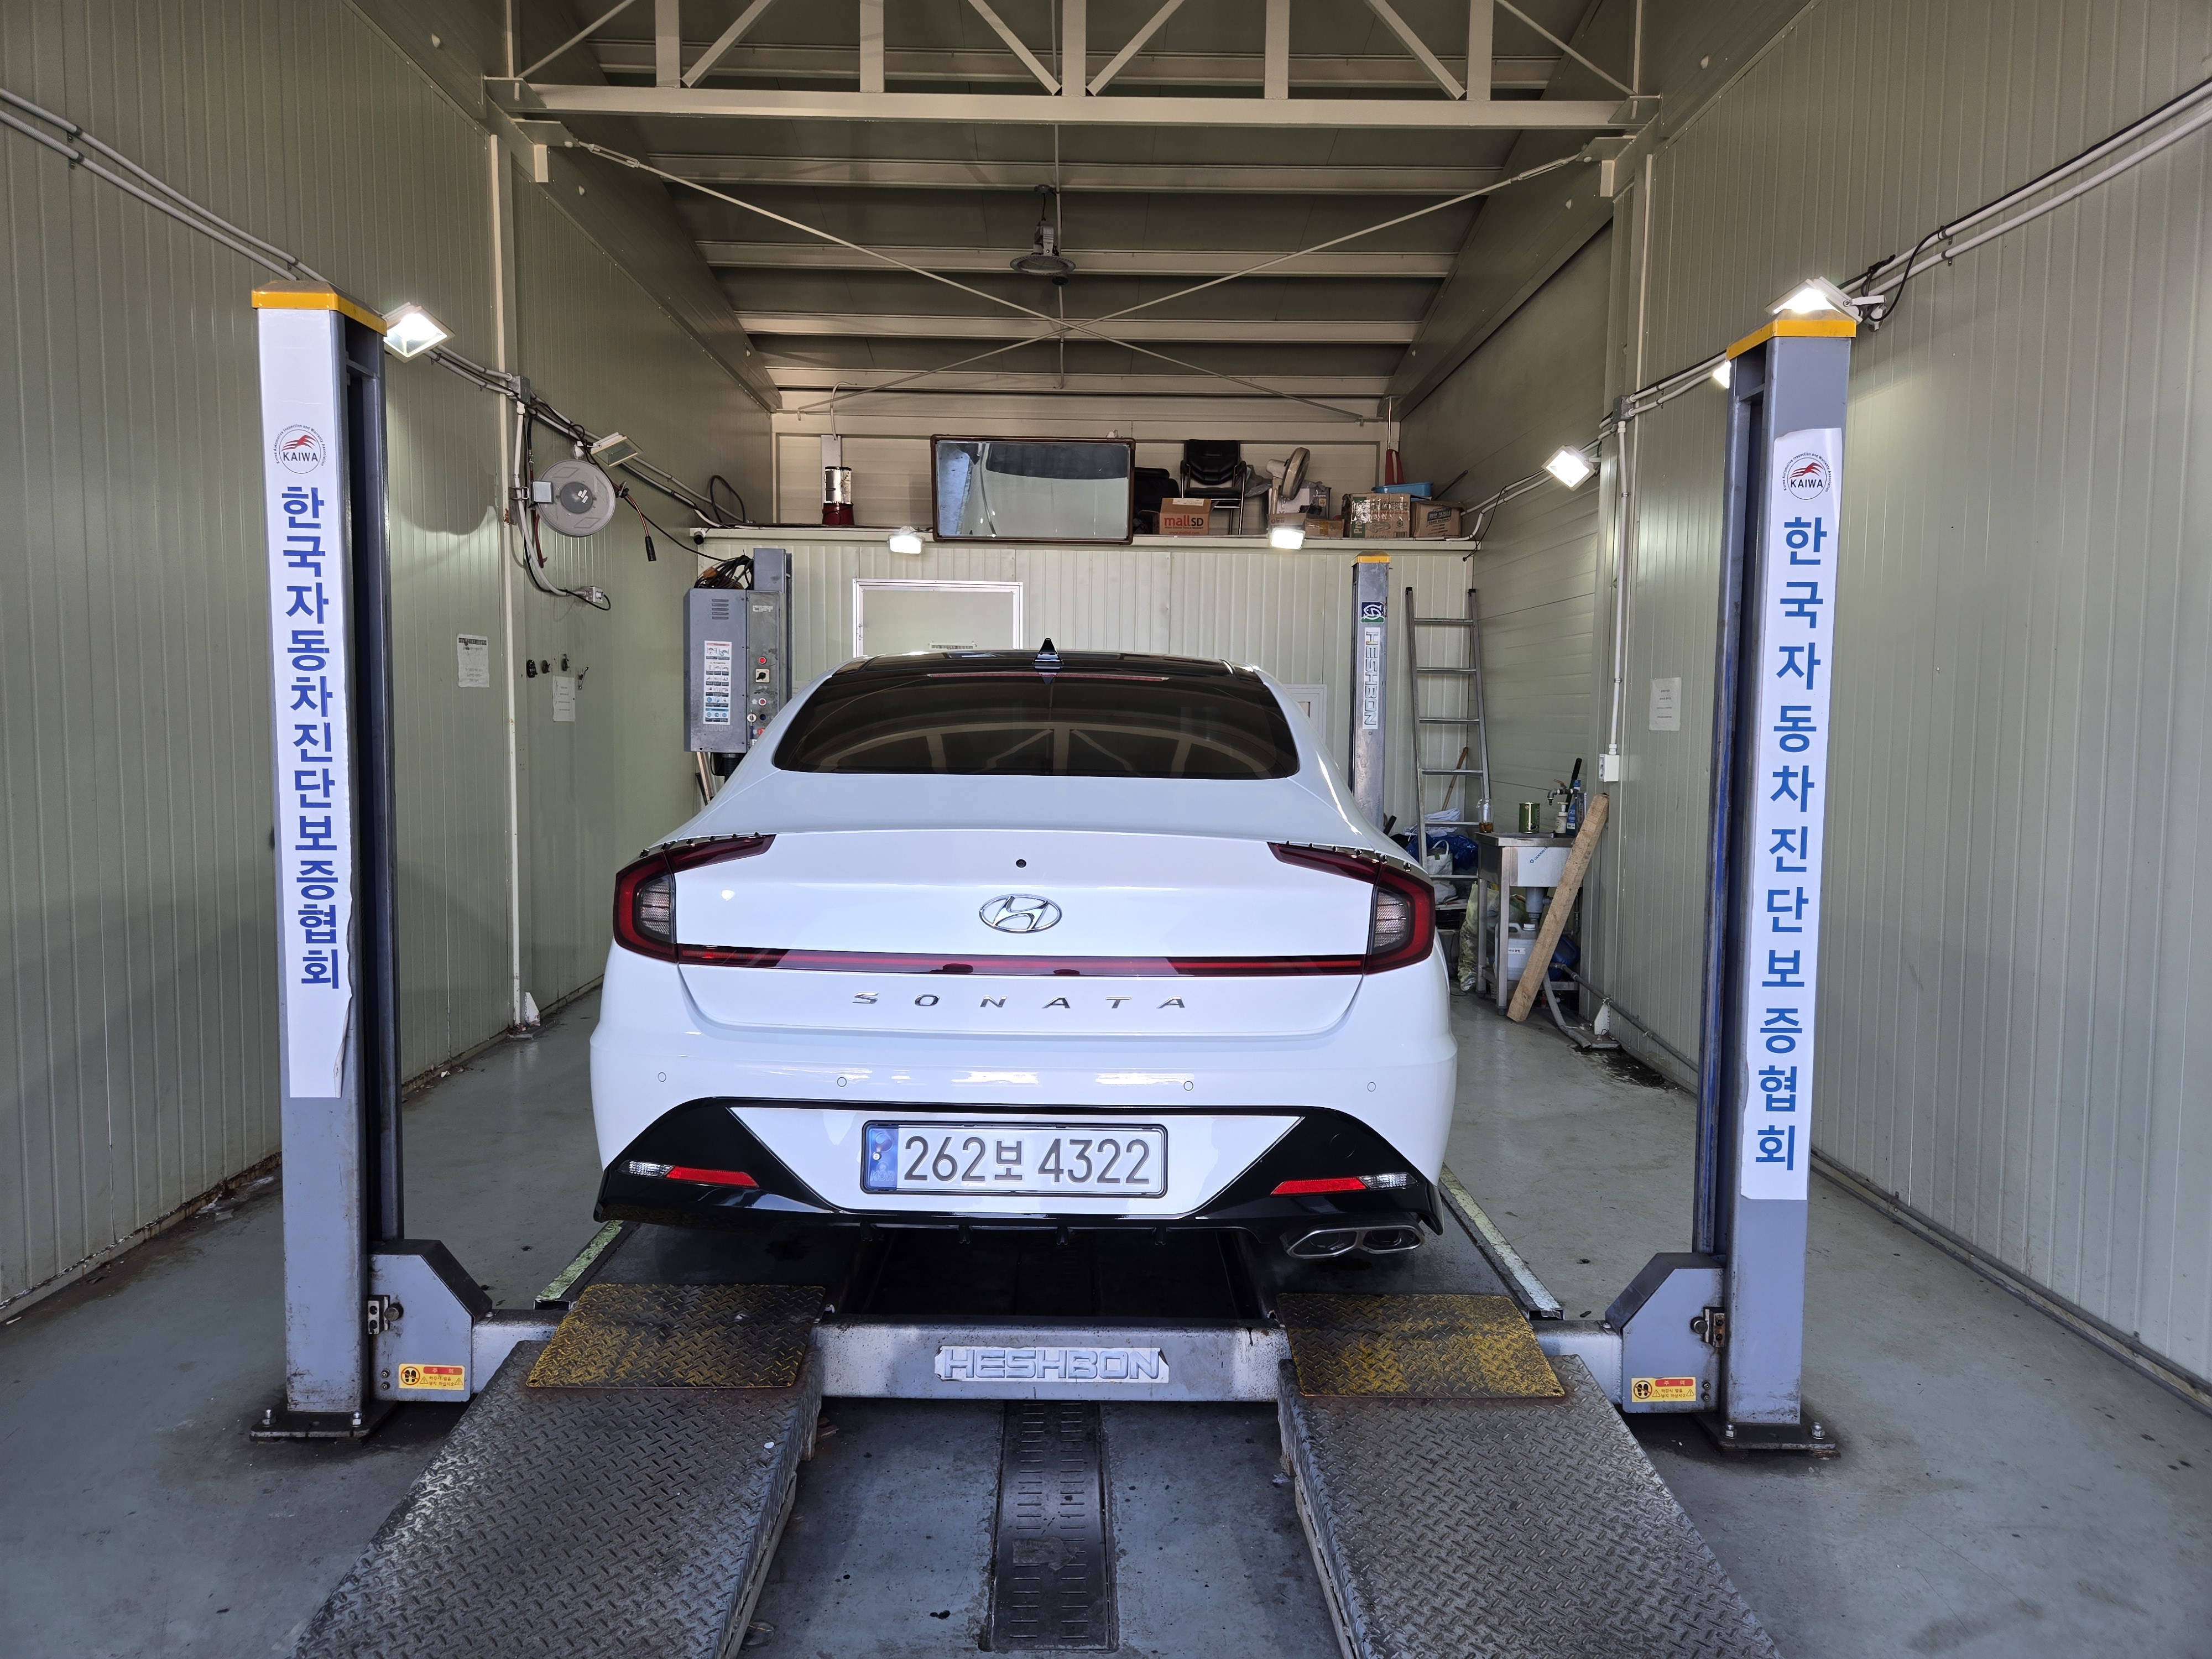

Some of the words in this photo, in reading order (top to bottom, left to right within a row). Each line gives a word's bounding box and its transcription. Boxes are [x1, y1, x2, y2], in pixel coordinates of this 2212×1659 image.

[283, 452, 318, 462] KAIWA
[1791, 479, 1823, 488] KAIWA
[1164, 515, 1203, 526] mallSD
[1364, 631, 1379, 726] HESHBON
[281, 487, 338, 989] 한국자동차진단보증협회
[1755, 517, 1827, 1171] 한국자동차진단보증협회
[852, 992, 1185, 1009] SONATA
[904, 1136, 1022, 1182] 262보
[1038, 1138, 1150, 1185] 4322
[870, 1170, 895, 1181] KOR
[945, 1349, 1159, 1379] HESHBON
